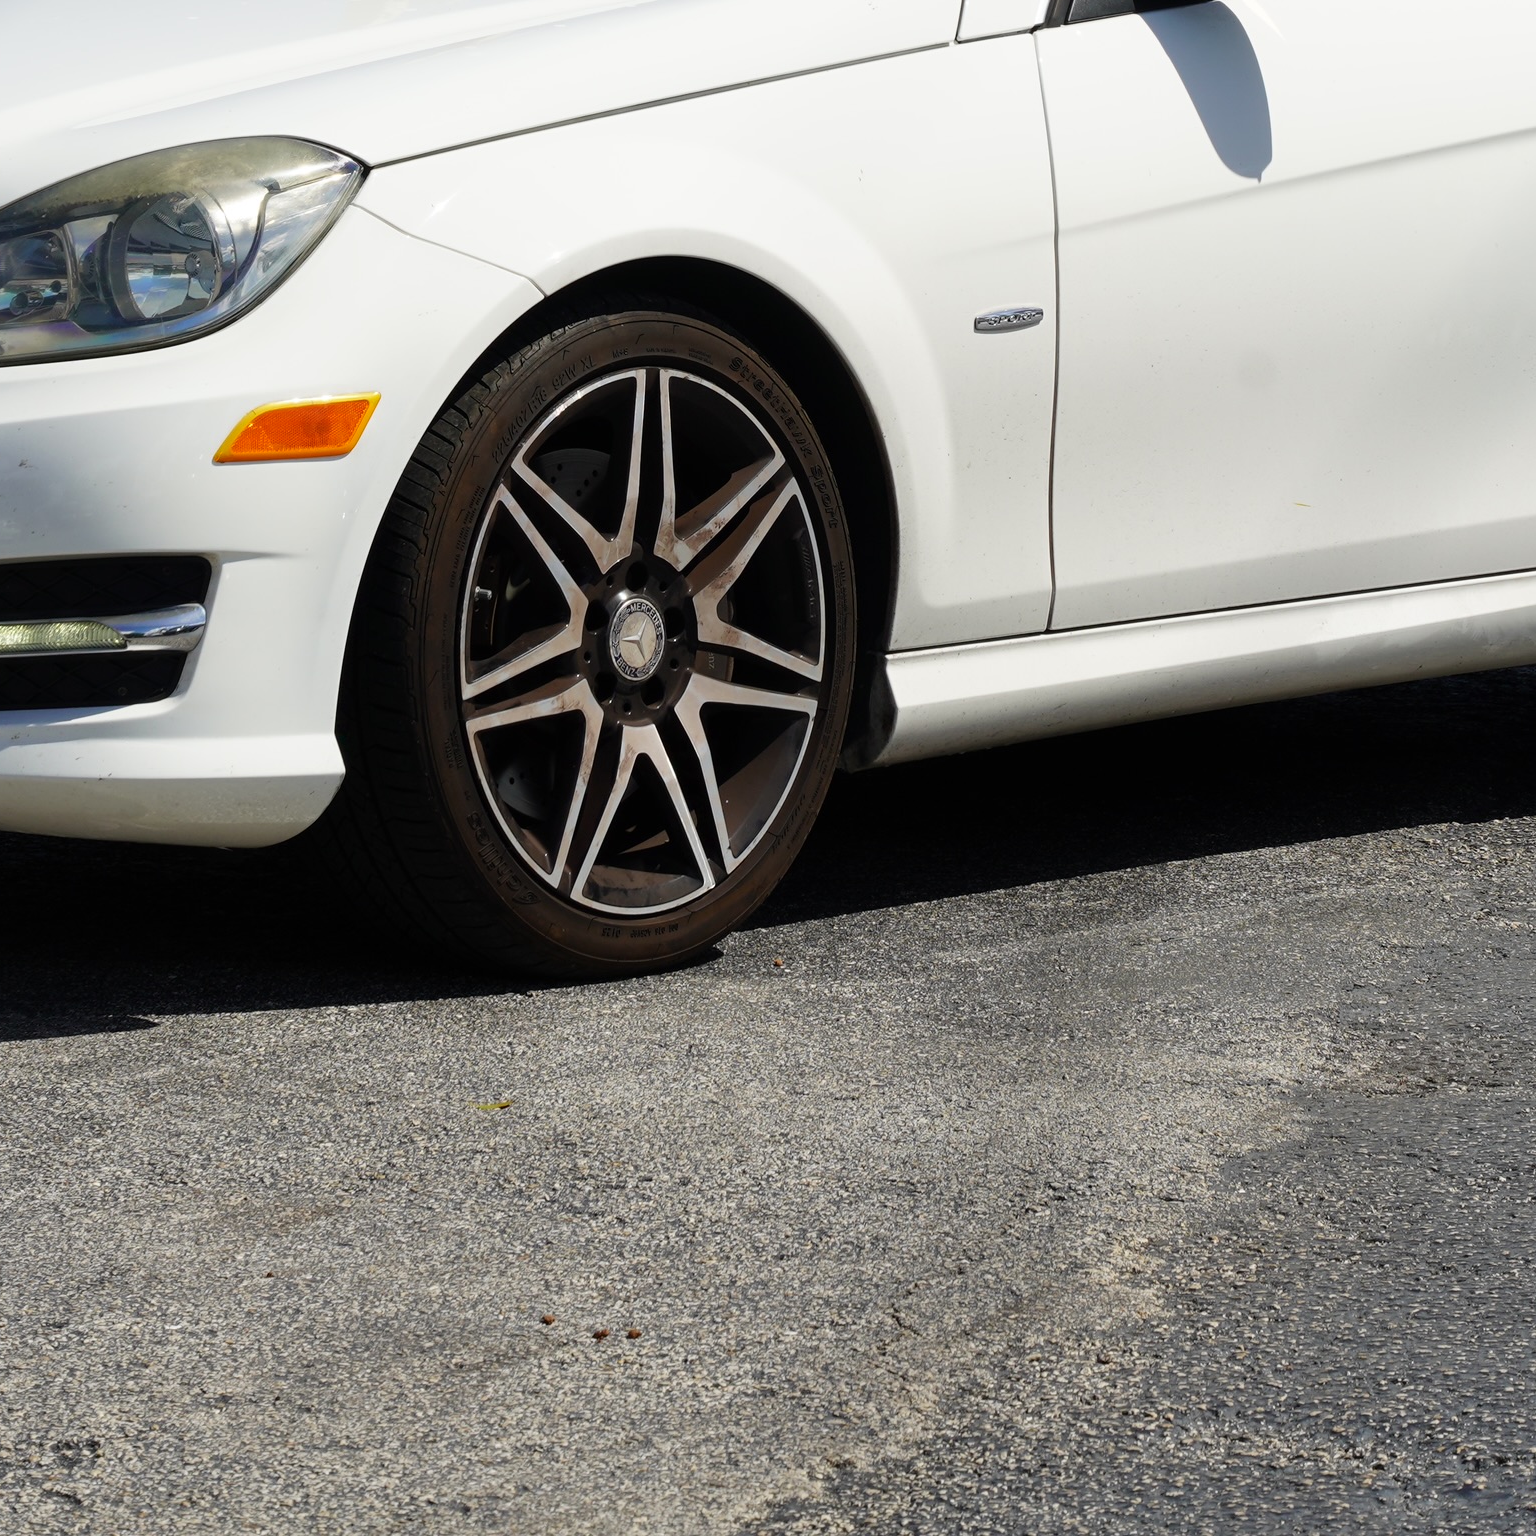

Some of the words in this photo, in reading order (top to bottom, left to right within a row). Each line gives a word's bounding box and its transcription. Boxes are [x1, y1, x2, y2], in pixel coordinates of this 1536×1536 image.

[810, 464, 839, 529] Sport
[630, 602, 663, 635] MERCEDES
[617, 658, 636, 677] BENZ
[467, 811, 541, 905] Achilles
